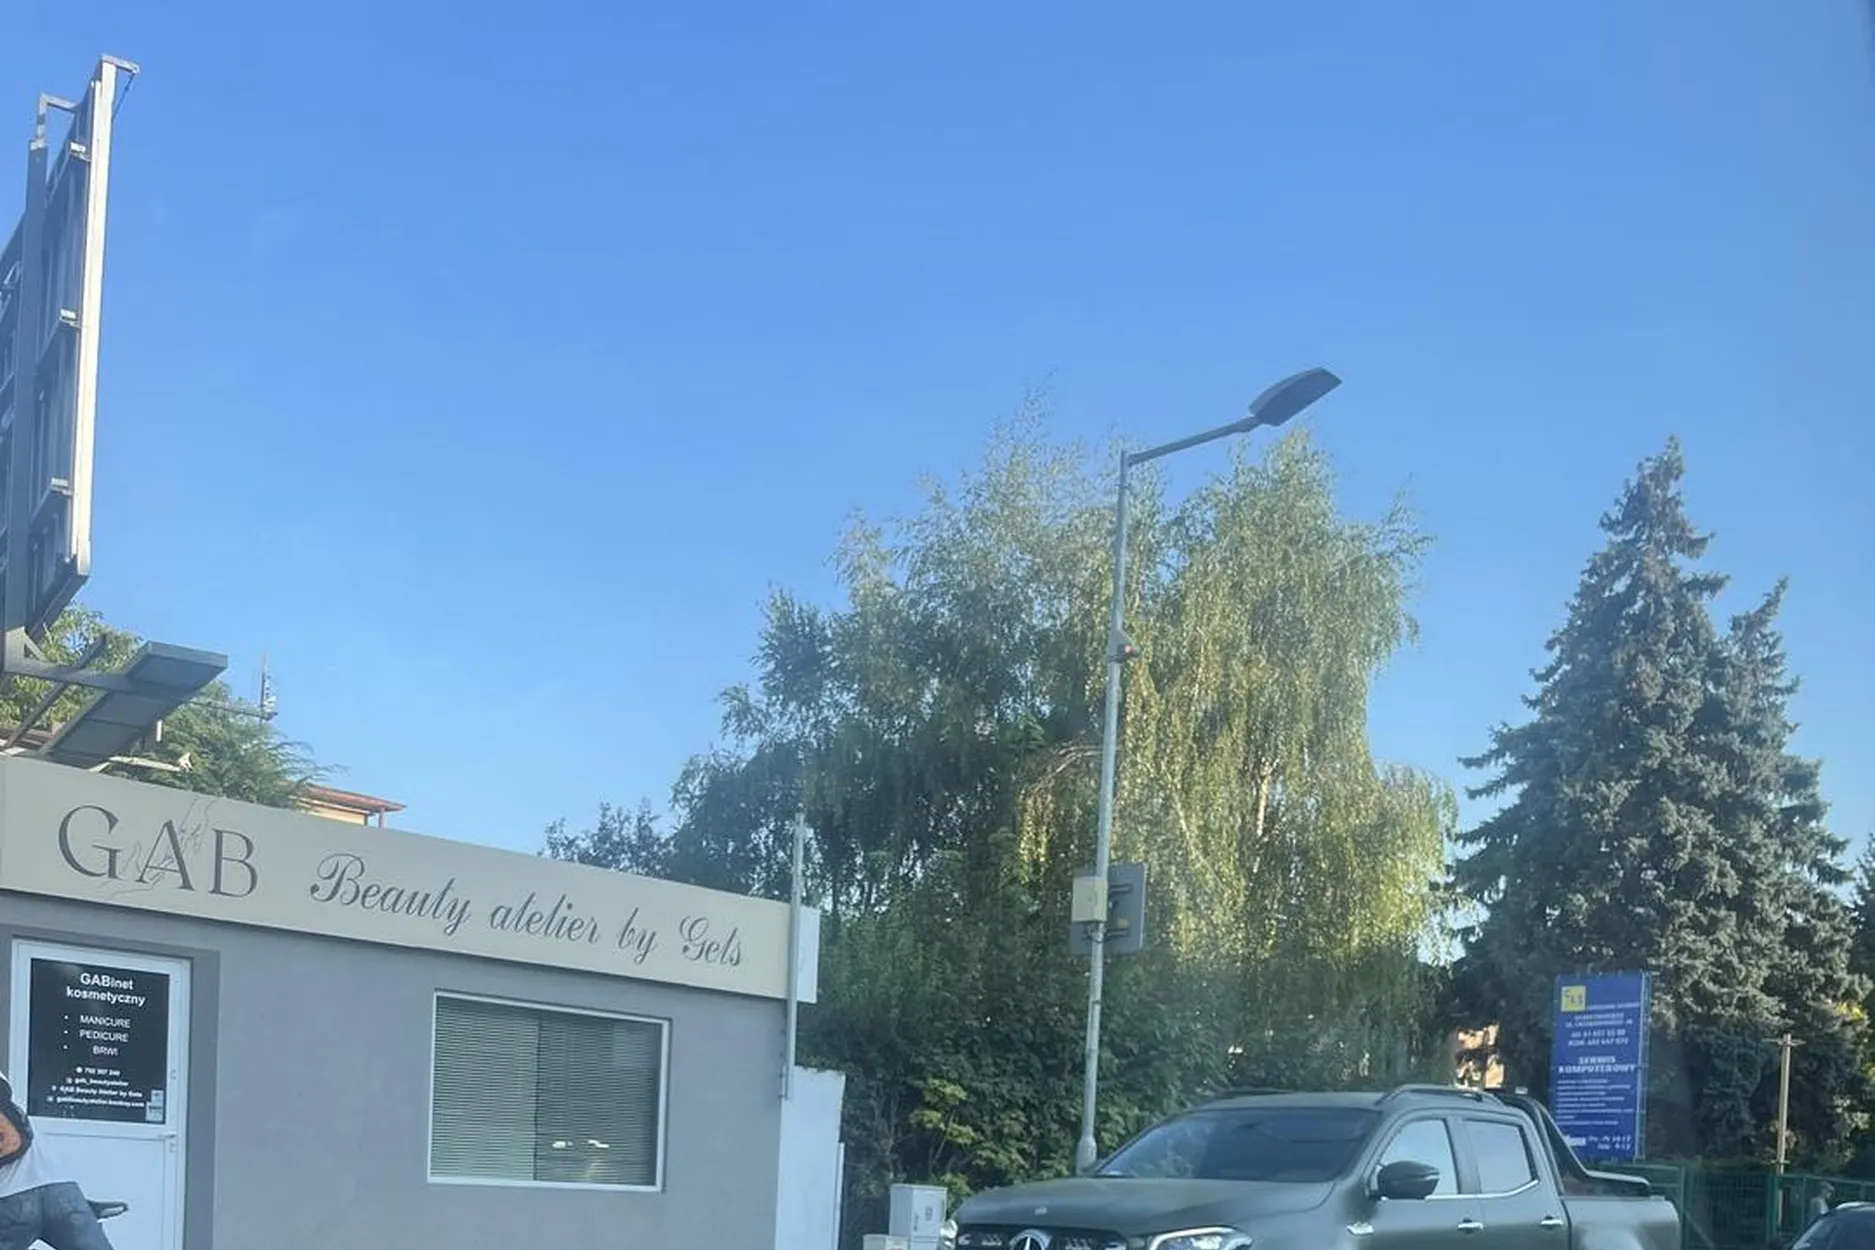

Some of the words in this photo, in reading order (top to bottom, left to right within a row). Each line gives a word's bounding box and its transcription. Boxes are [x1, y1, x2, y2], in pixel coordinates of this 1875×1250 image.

[58, 804, 259, 898] GAB
[309, 853, 471, 936] Beauty
[489, 891, 600, 945] atelier
[617, 907, 658, 966] by
[678, 915, 747, 967] Gels
[66, 986, 146, 1007] kosmetyczny
[80, 1014, 131, 1029] MANICURE
[79, 1029, 129, 1042] PEDICURE
[93, 1045, 118, 1056] BRWI
[1558, 1063, 1636, 1075] KOMPUTEROWY
